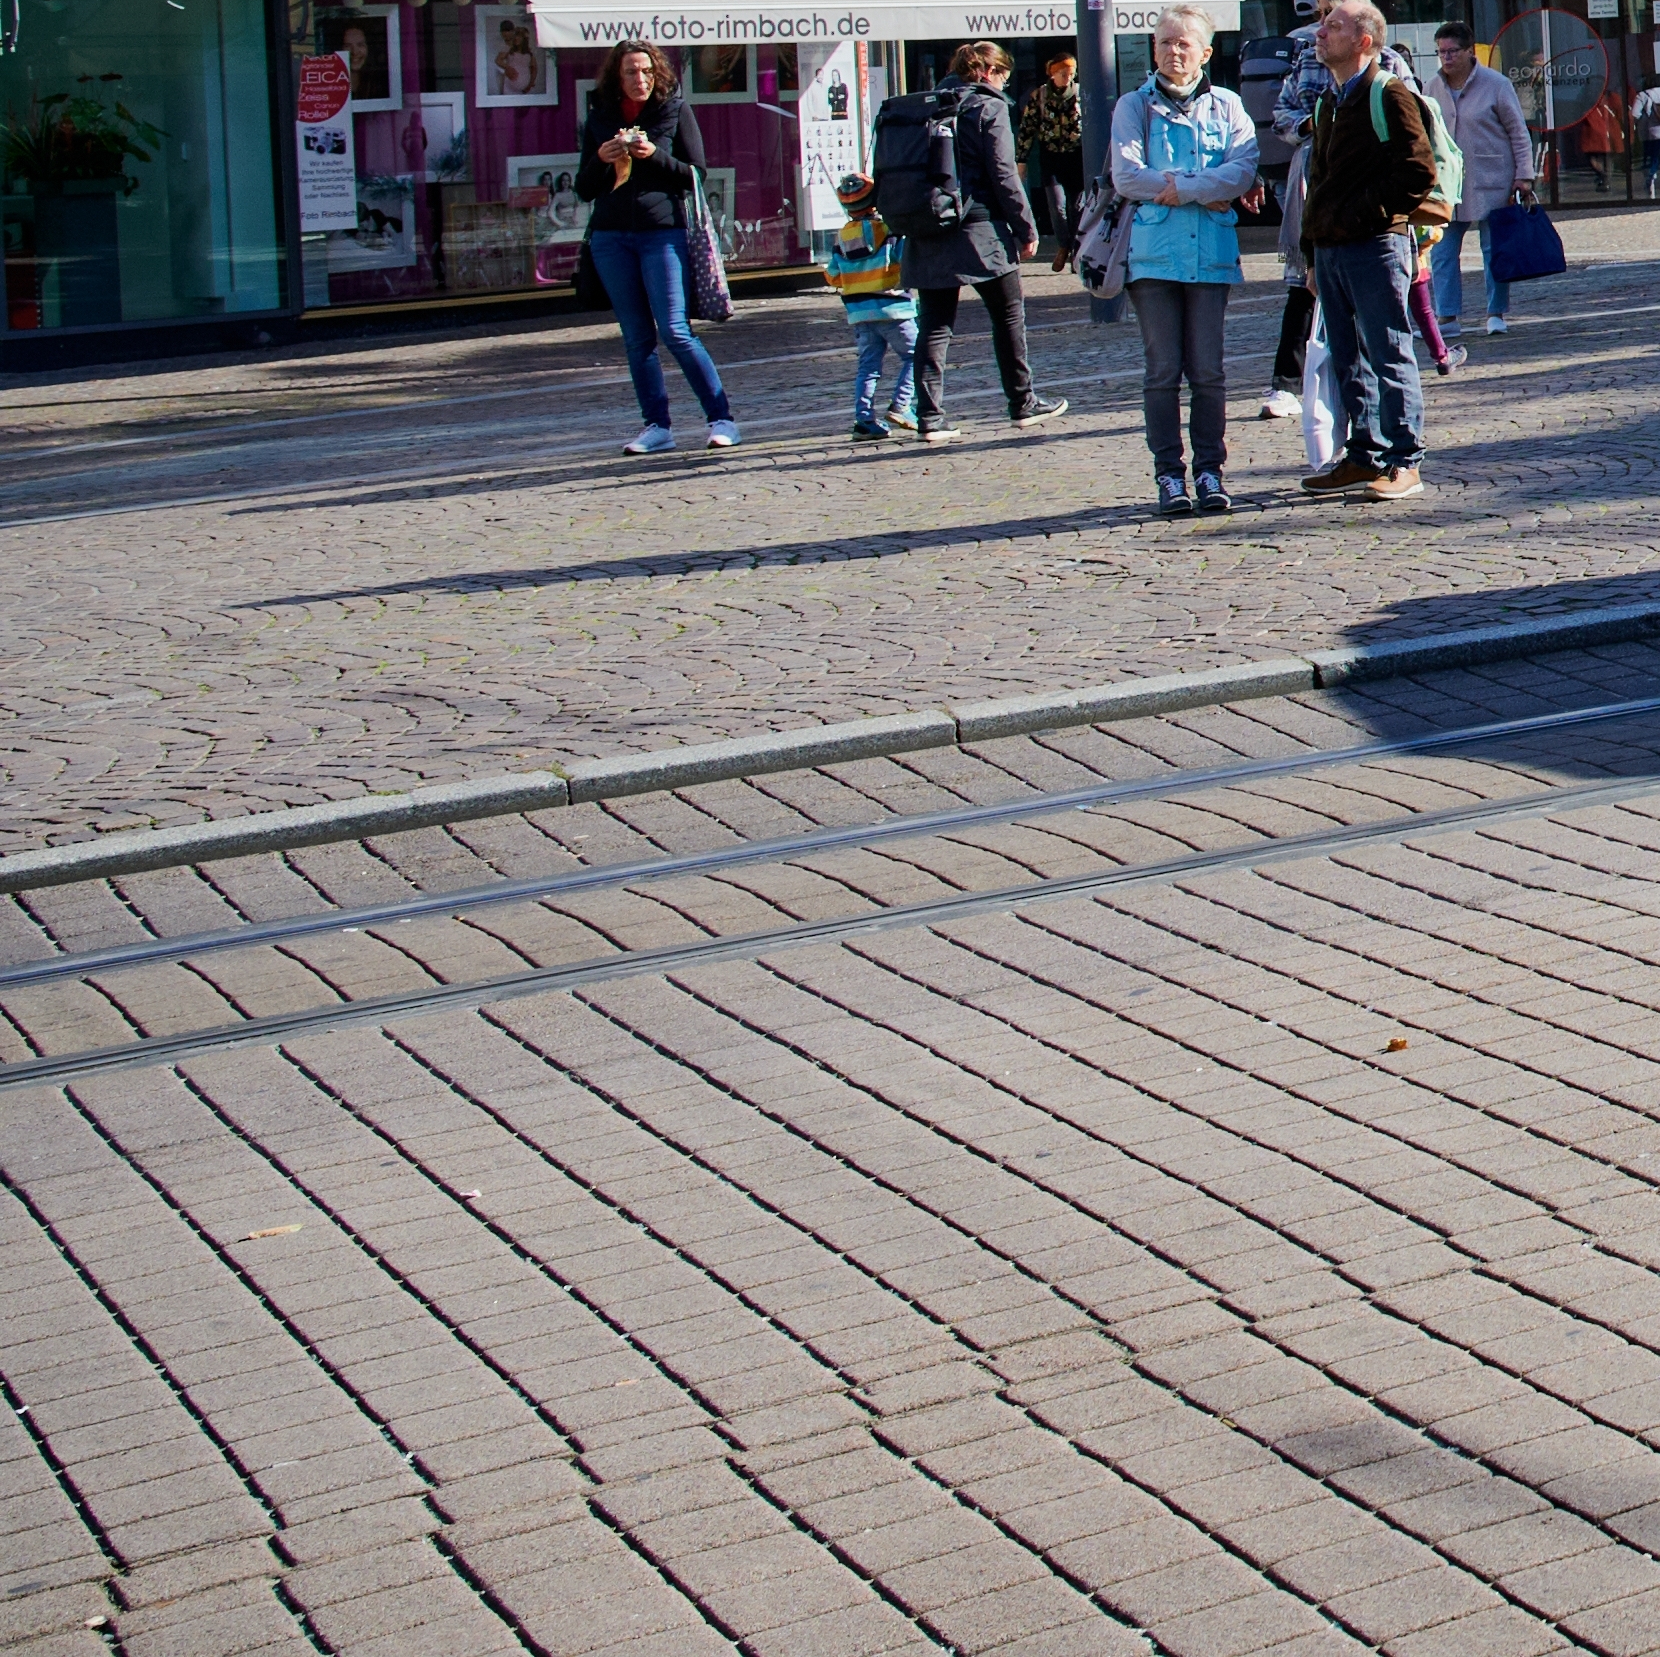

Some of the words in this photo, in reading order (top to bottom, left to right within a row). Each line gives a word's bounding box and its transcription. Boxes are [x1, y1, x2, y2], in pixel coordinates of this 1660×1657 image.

[579, 11, 872, 42] www.foto-rimbach.de
[314, 102, 341, 110] Canon
[299, 109, 330, 120] Rollei
